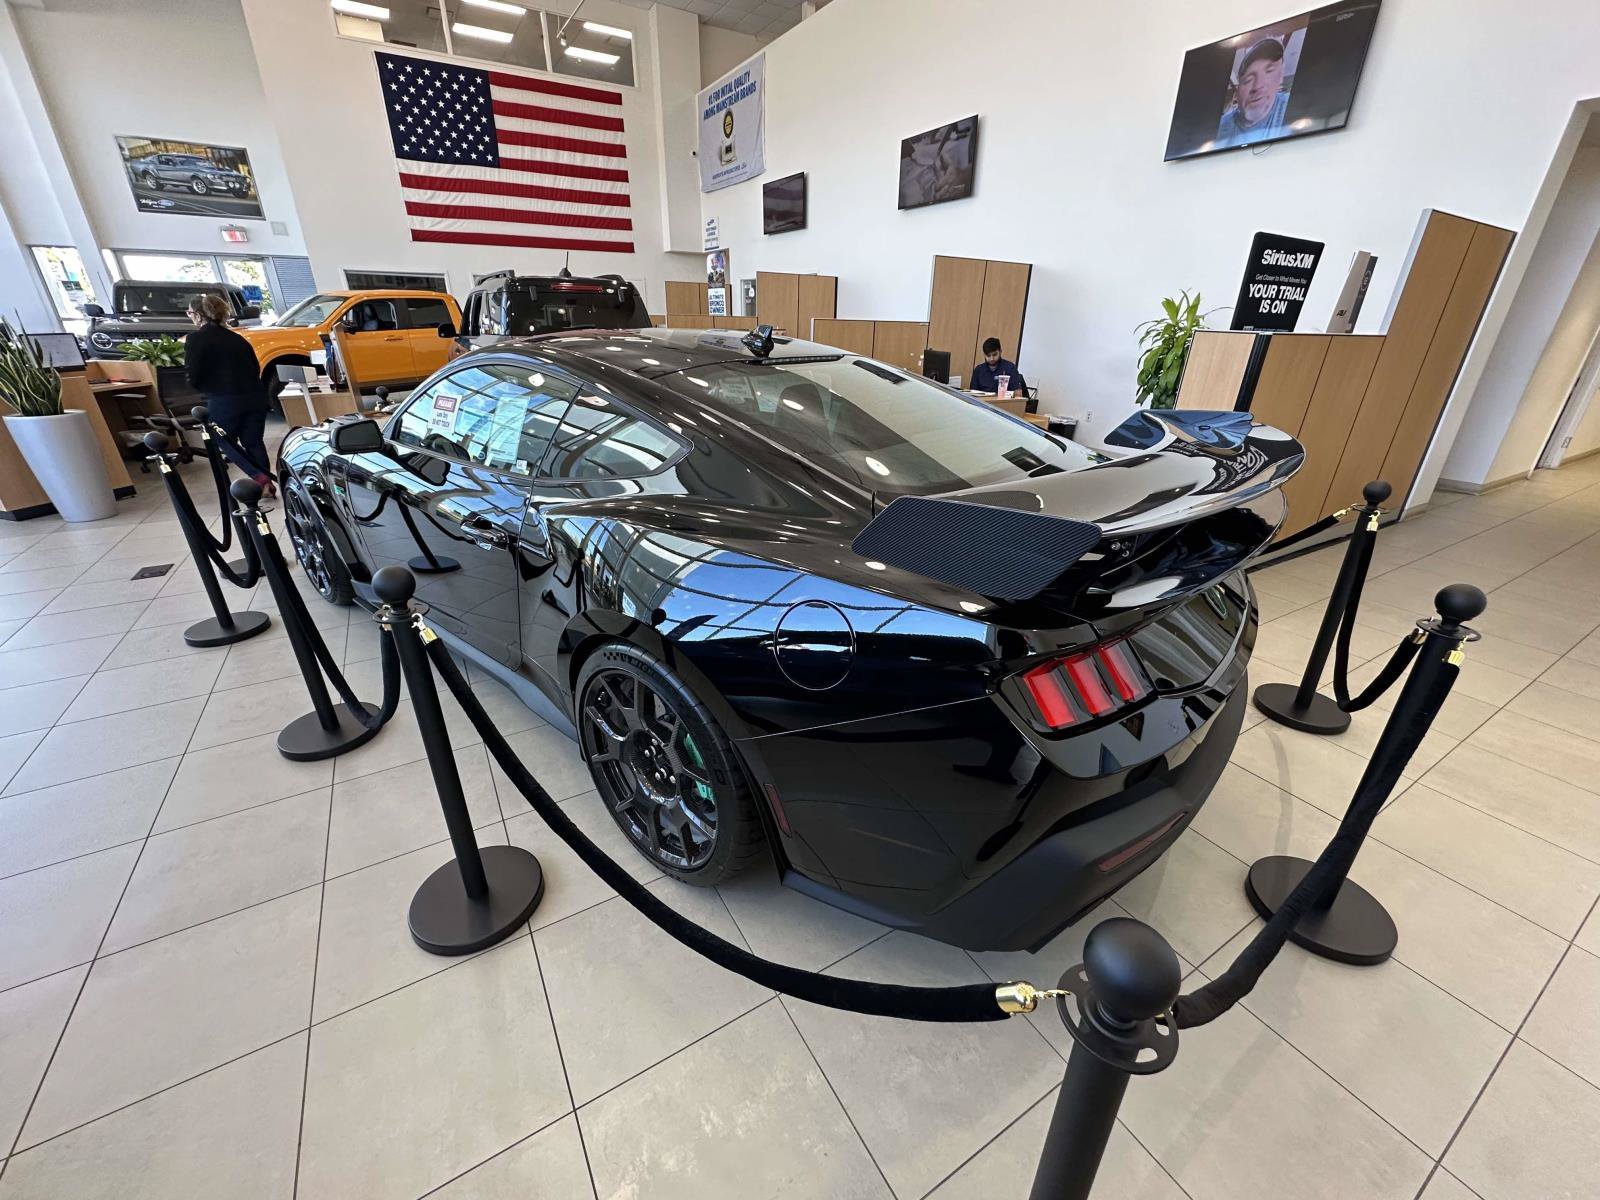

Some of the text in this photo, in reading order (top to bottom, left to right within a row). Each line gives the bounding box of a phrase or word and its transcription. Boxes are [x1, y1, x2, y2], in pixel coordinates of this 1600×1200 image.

[734, 69, 750, 91] QUALITY
[740, 80, 756, 100] BRANDS
[1262, 249, 1316, 269] SiriusXM
[1249, 284, 1305, 301] YOUR TRIAL
[1258, 300, 1288, 314] IS ON
[438, 399, 453, 408] PLEASE
